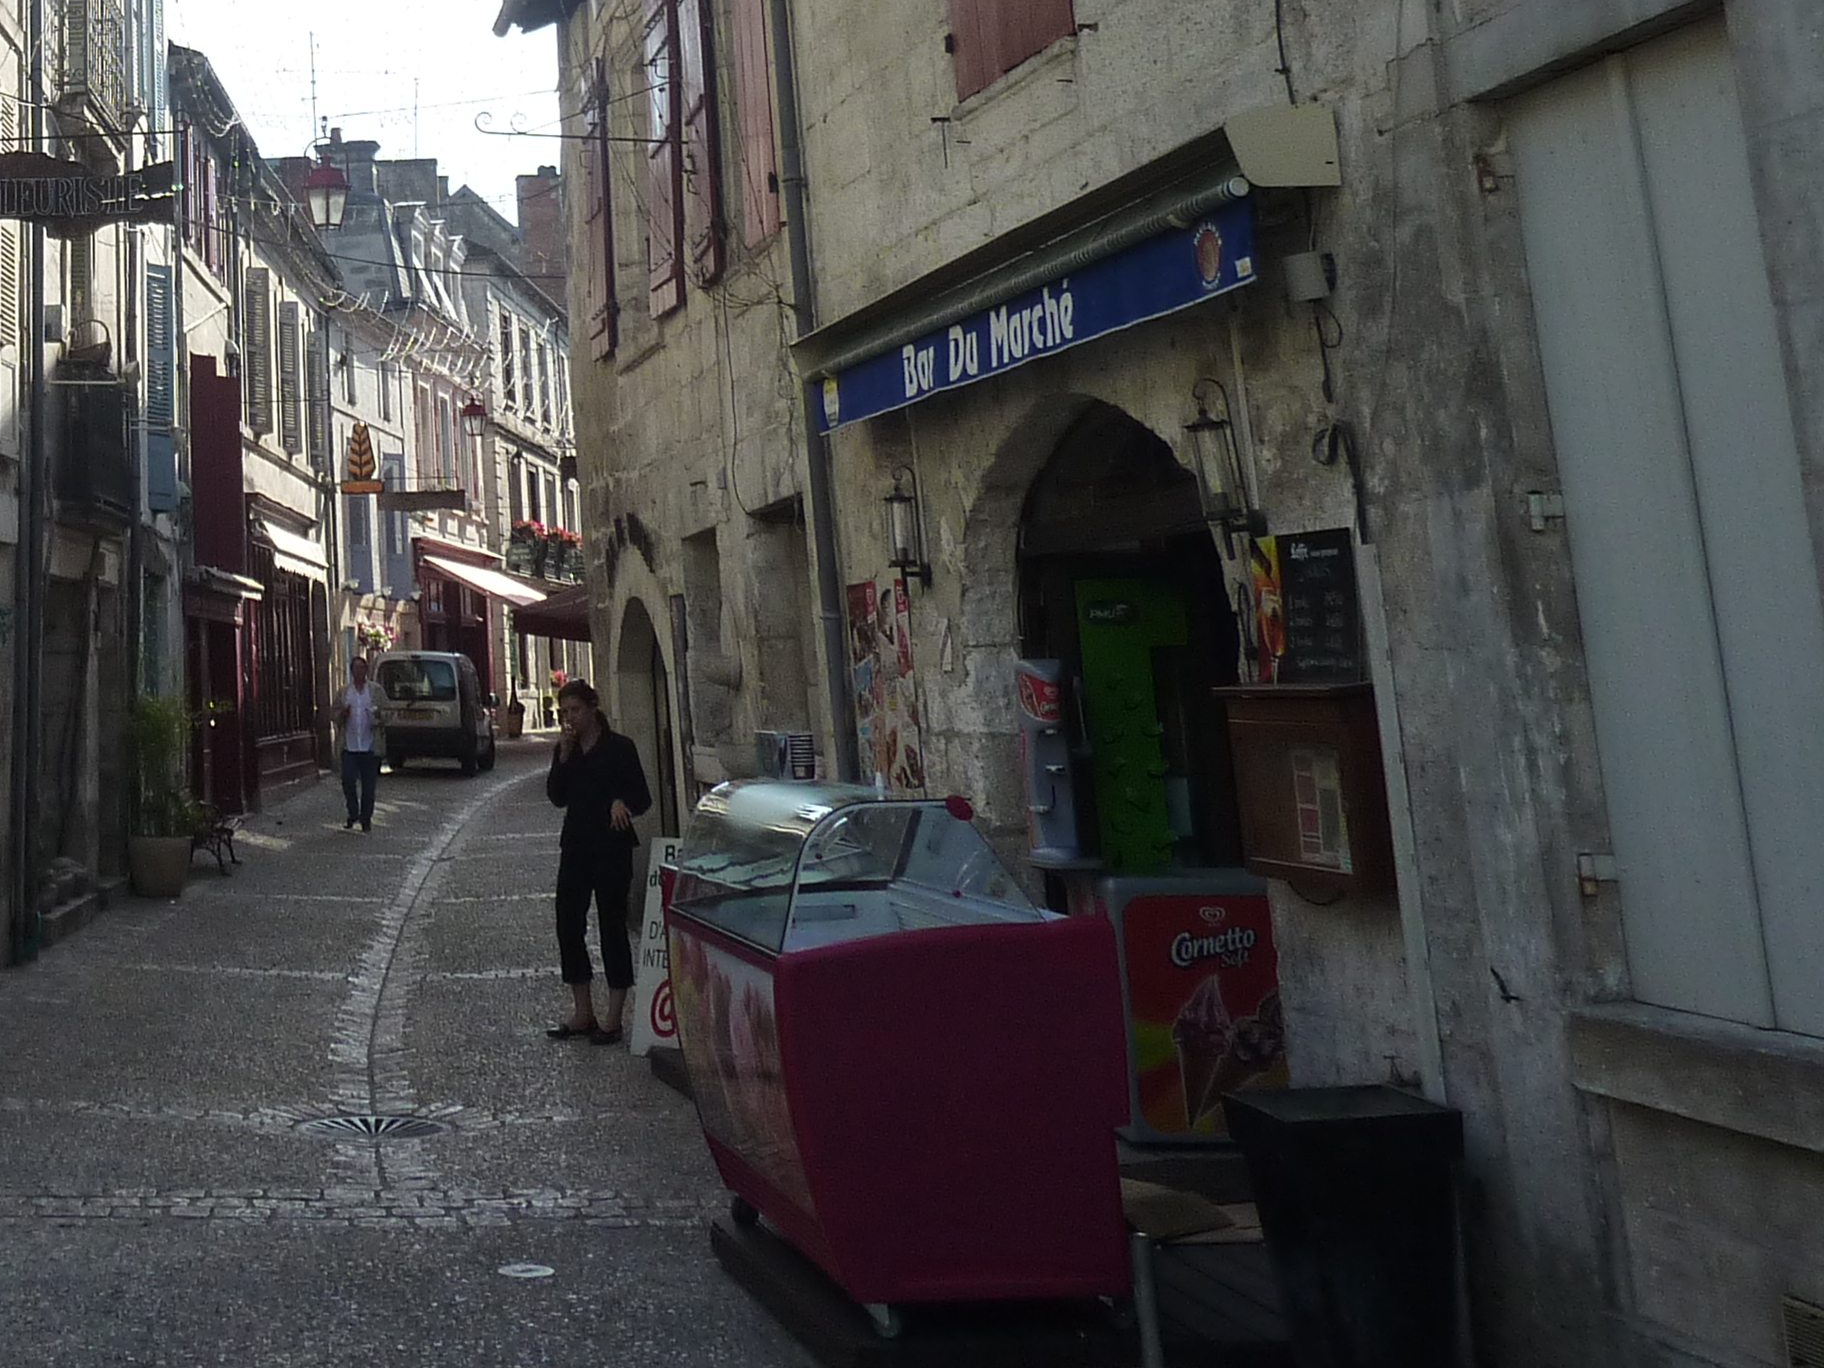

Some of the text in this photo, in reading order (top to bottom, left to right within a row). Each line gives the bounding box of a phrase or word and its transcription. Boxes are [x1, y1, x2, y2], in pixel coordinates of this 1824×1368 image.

[902, 277, 1075, 399] Bar Du Marché
[1089, 608, 1115, 620] PMU
[1171, 927, 1256, 969] Cornetto
[1220, 948, 1250, 969] Soft
